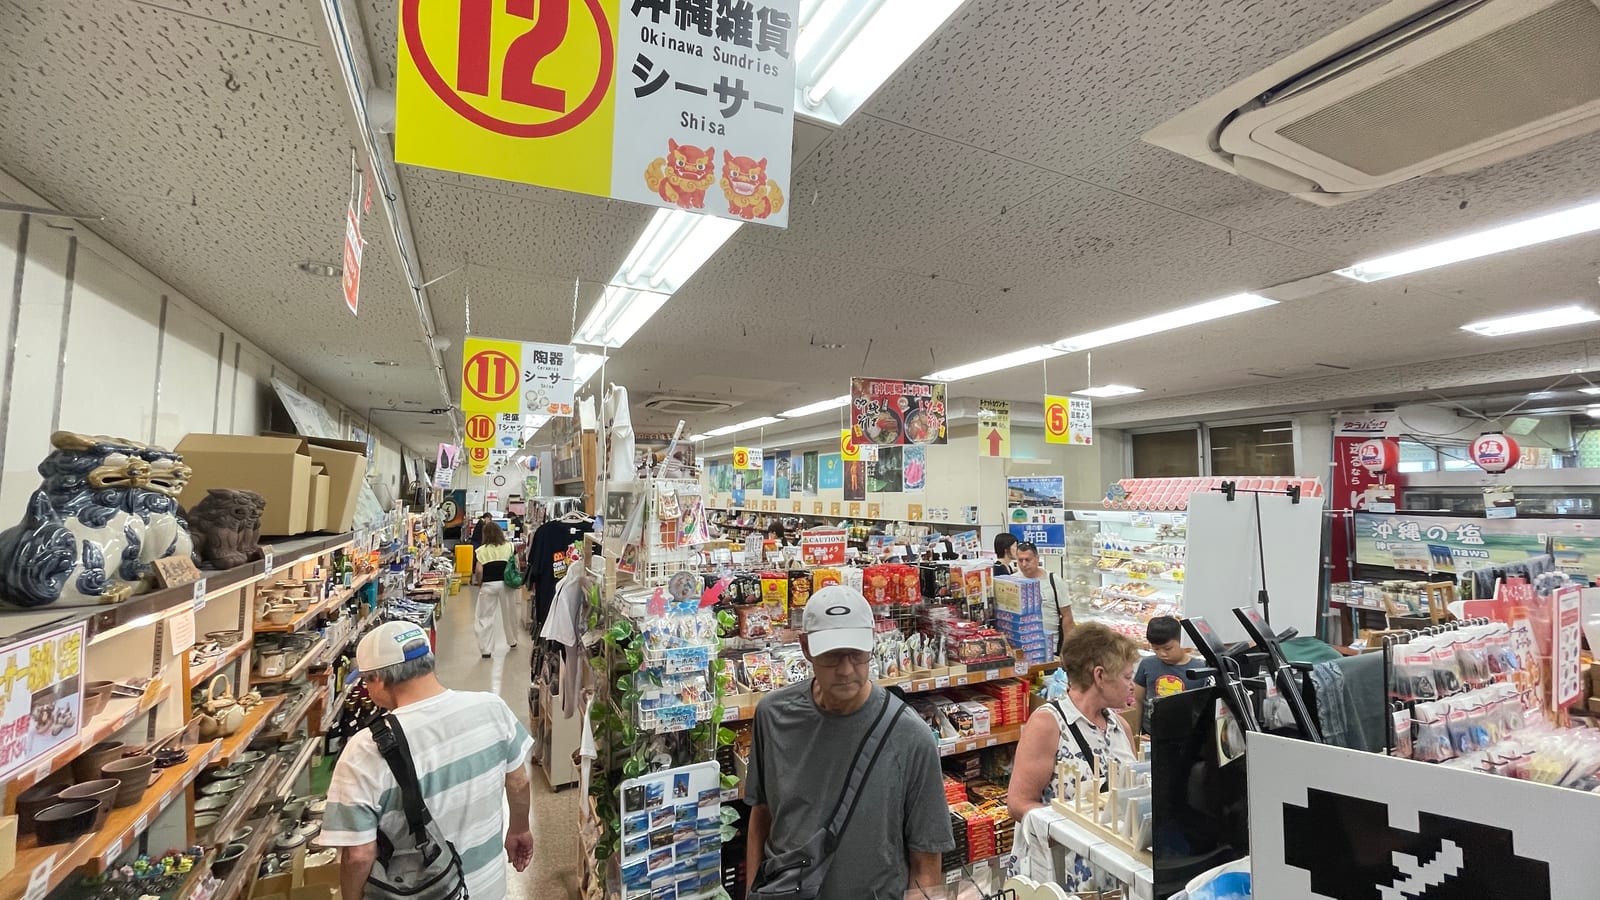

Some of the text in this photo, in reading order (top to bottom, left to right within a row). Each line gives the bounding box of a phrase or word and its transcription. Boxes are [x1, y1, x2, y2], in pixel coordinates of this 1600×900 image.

[457, 0, 569, 113] 12
[641, 26, 779, 77] Okinawa Sundries
[631, 53, 785, 119] シーサー
[680, 111, 726, 136] Shisa
[533, 350, 564, 366] 陶器
[475, 356, 507, 395] 11
[524, 370, 573, 385] シーサー
[471, 418, 490, 438] 10
[1051, 407, 1064, 431] 5
[1343, 419, 1387, 429] ゆうパック
[737, 453, 745, 464] 3
[1023, 530, 1048, 543] 許田
[1371, 520, 1485, 545] 沖縄の塩
